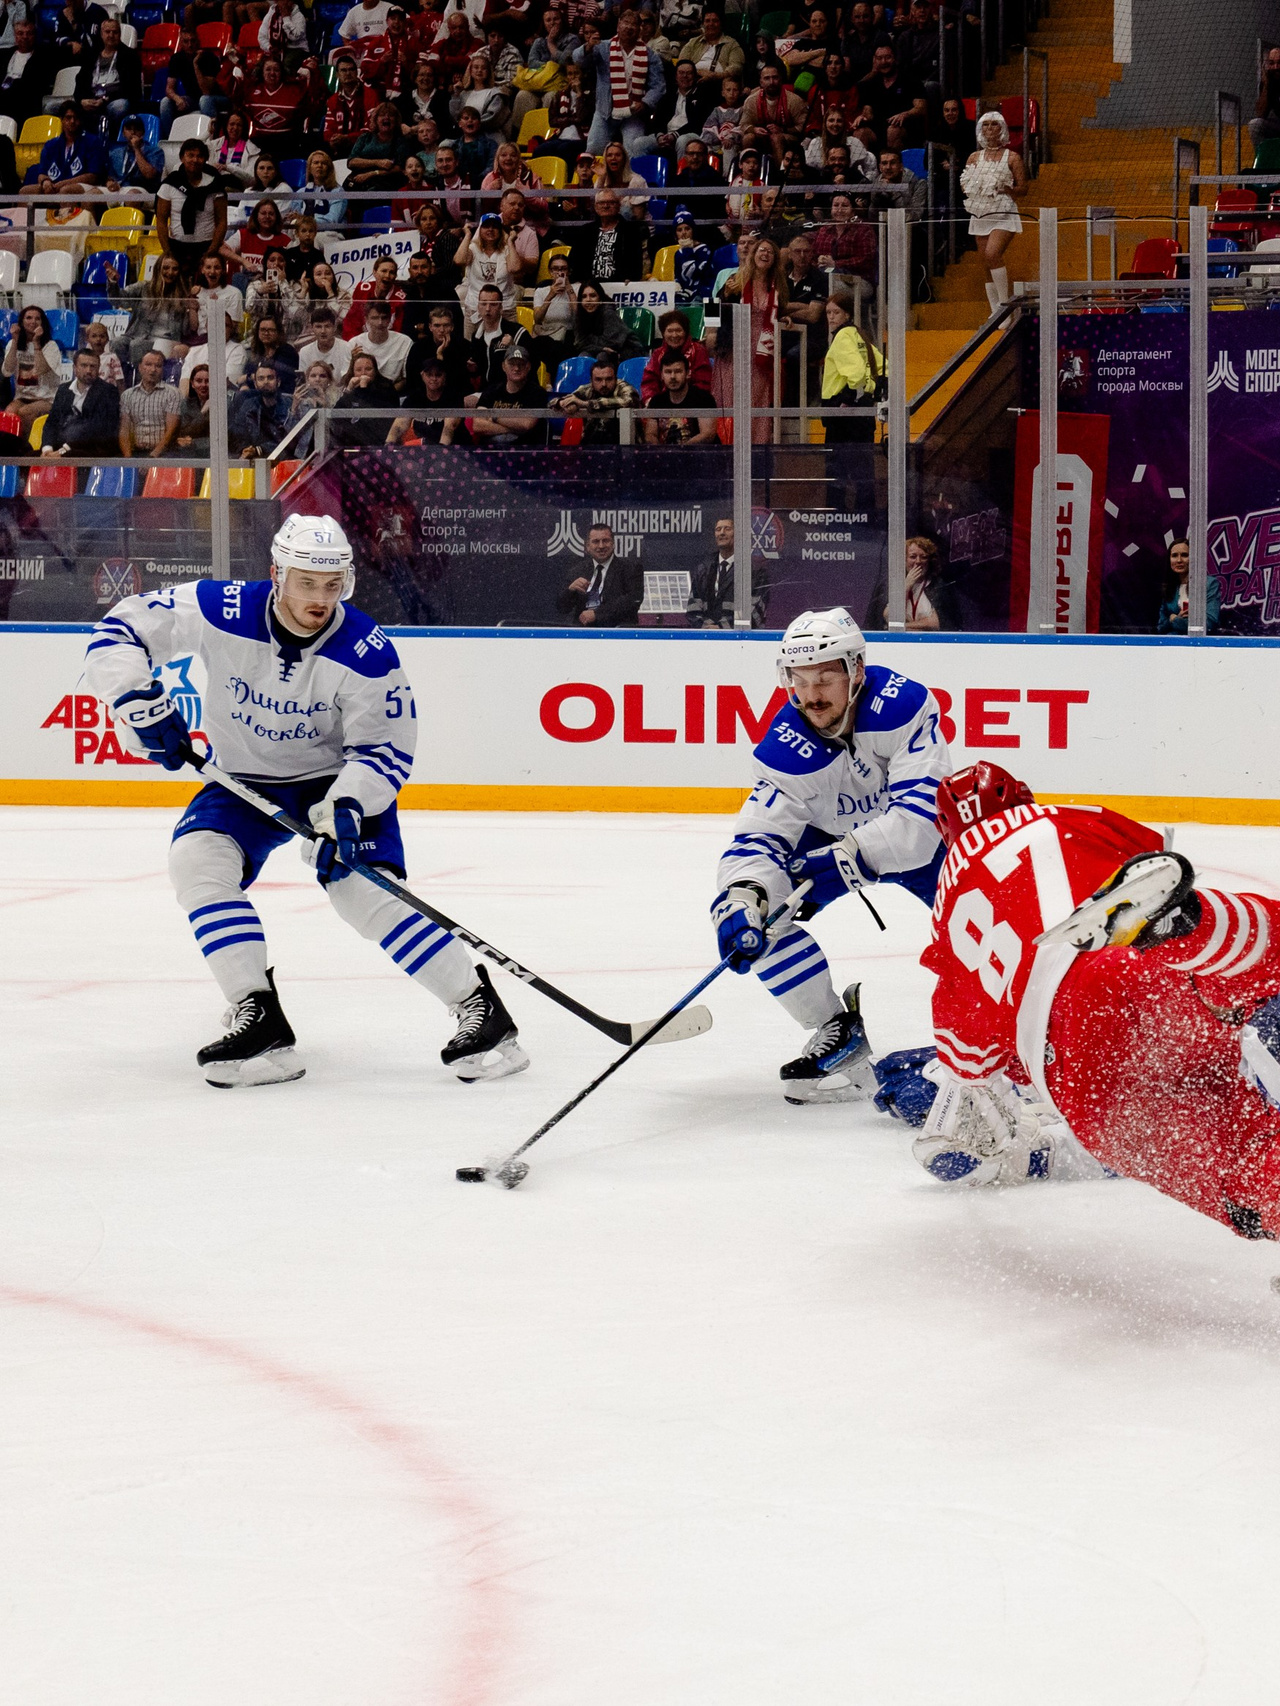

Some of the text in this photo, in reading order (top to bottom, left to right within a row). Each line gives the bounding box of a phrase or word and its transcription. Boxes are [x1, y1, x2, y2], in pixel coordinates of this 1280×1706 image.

[330, 241, 412, 266] Я БОЛЕЮ ЗА
[650, 291, 668, 307] ЗА
[1097, 349, 1172, 362] Департамент
[1098, 367, 1135, 378] спорта
[1098, 380, 1183, 394] города Москвы
[421, 506, 507, 521] Департамент
[789, 510, 868, 525] Федерация
[314, 532, 332, 544] 57
[422, 525, 466, 538] спорта
[805, 532, 852, 542] хоккея
[422, 541, 521, 556] города Москвы
[614, 535, 643, 558] ОРТ
[752, 535, 777, 548] ХМ
[311, 556, 341, 565] согаз
[802, 548, 855, 561] Москвы
[146, 561, 213, 576] Федерация
[100, 583, 134, 595] ФХМ
[223, 585, 241, 620] ВТБ
[794, 621, 814, 632] 27
[787, 645, 815, 655] согаз
[880, 673, 907, 699] ВТБ
[540, 682, 1089, 750] OLIMBET
[908, 713, 939, 754] 27
[778, 731, 817, 759] ВТБ
[956, 794, 982, 824] 87
[947, 817, 1076, 1007] 87
[450, 926, 537, 984] CCM
